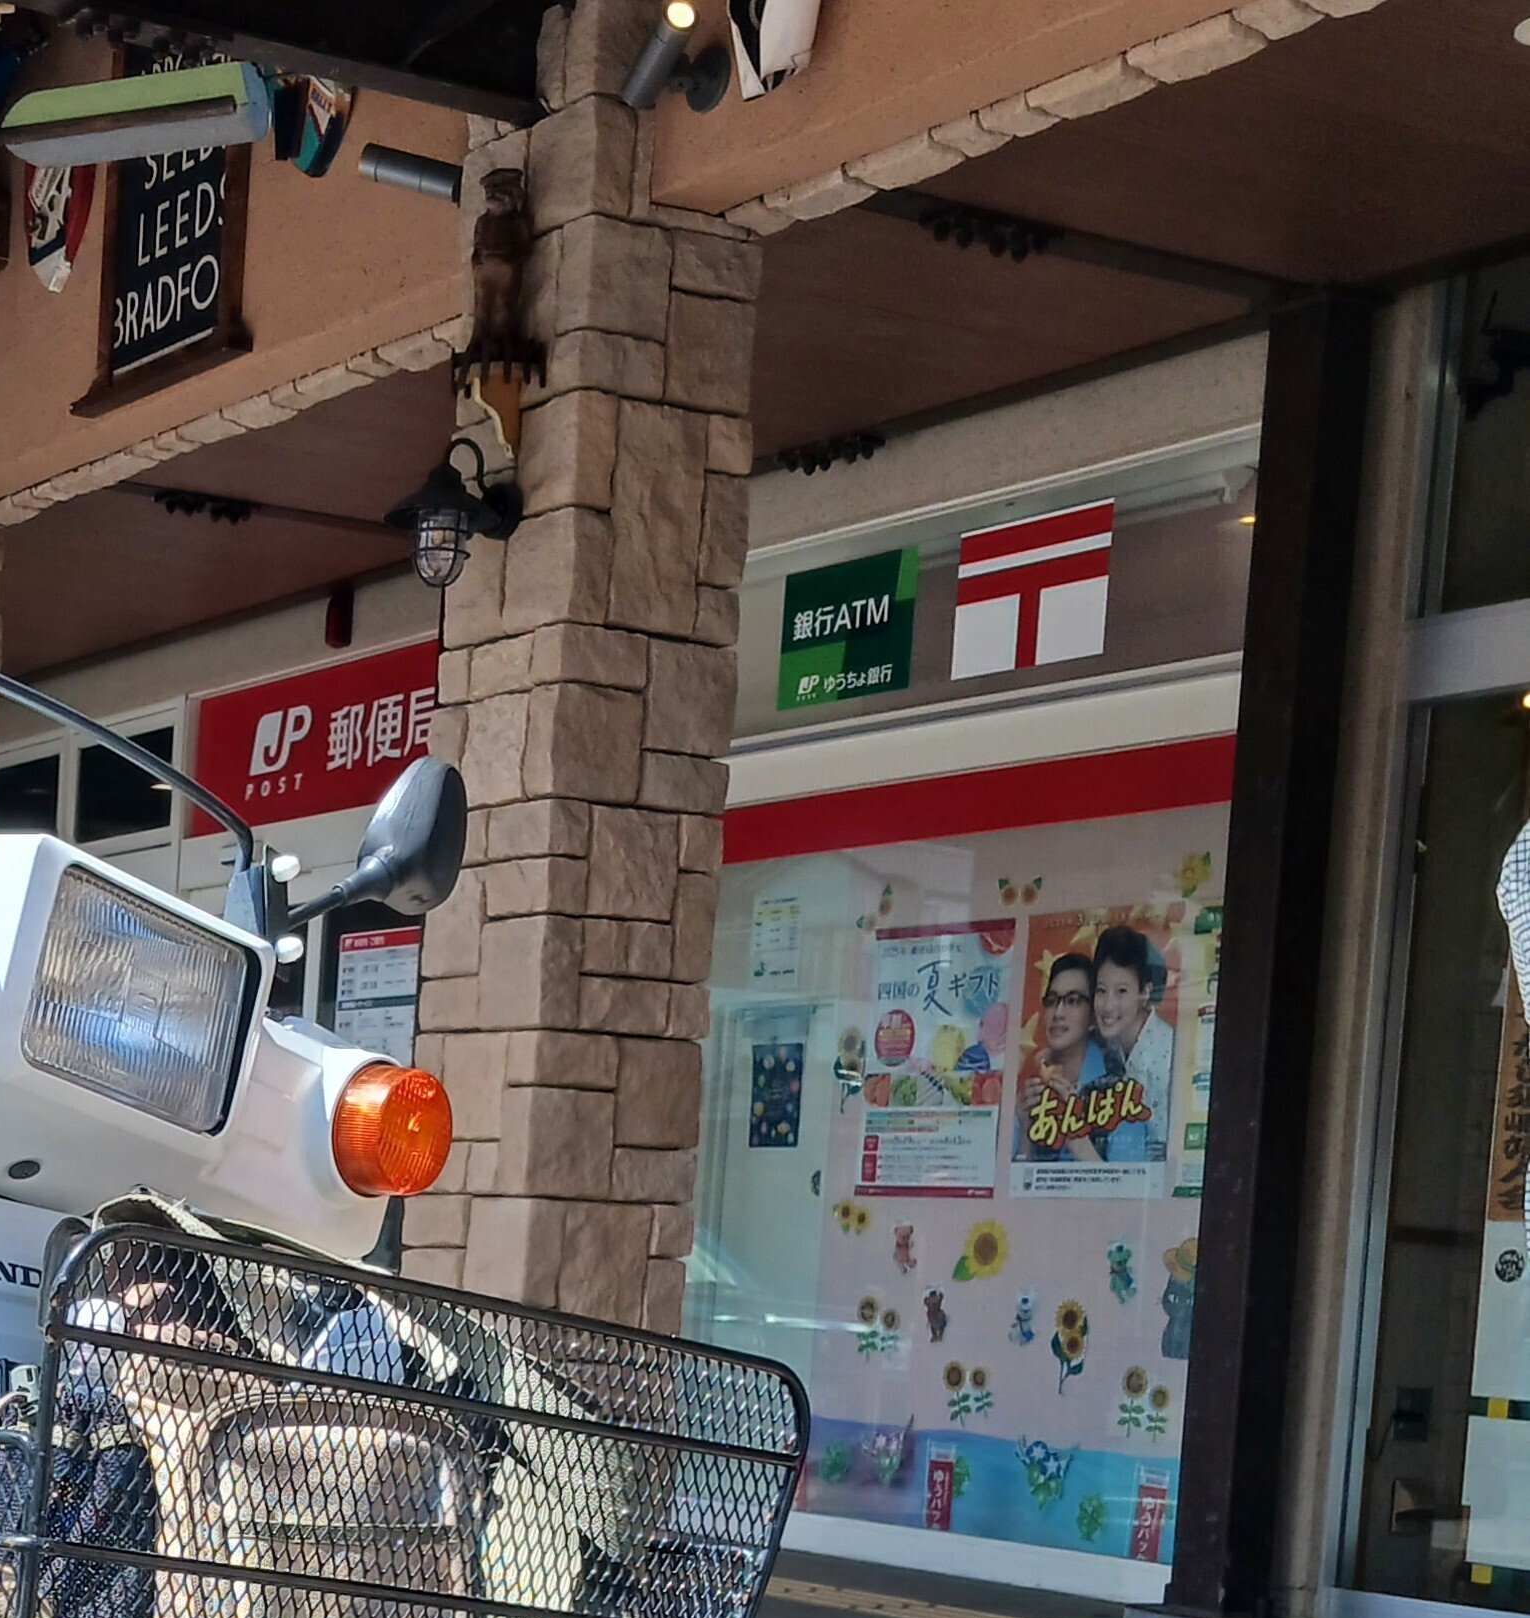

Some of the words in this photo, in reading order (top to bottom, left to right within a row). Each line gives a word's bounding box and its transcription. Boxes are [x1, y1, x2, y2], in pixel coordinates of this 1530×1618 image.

[792, 594, 890, 642] 銀行ATM
[823, 663, 893, 693] ゆうちょ銀行
[326, 686, 436, 772] 郵便局
[245, 772, 304, 802] POST
[1028, 1080, 1143, 1146] あんぱん
